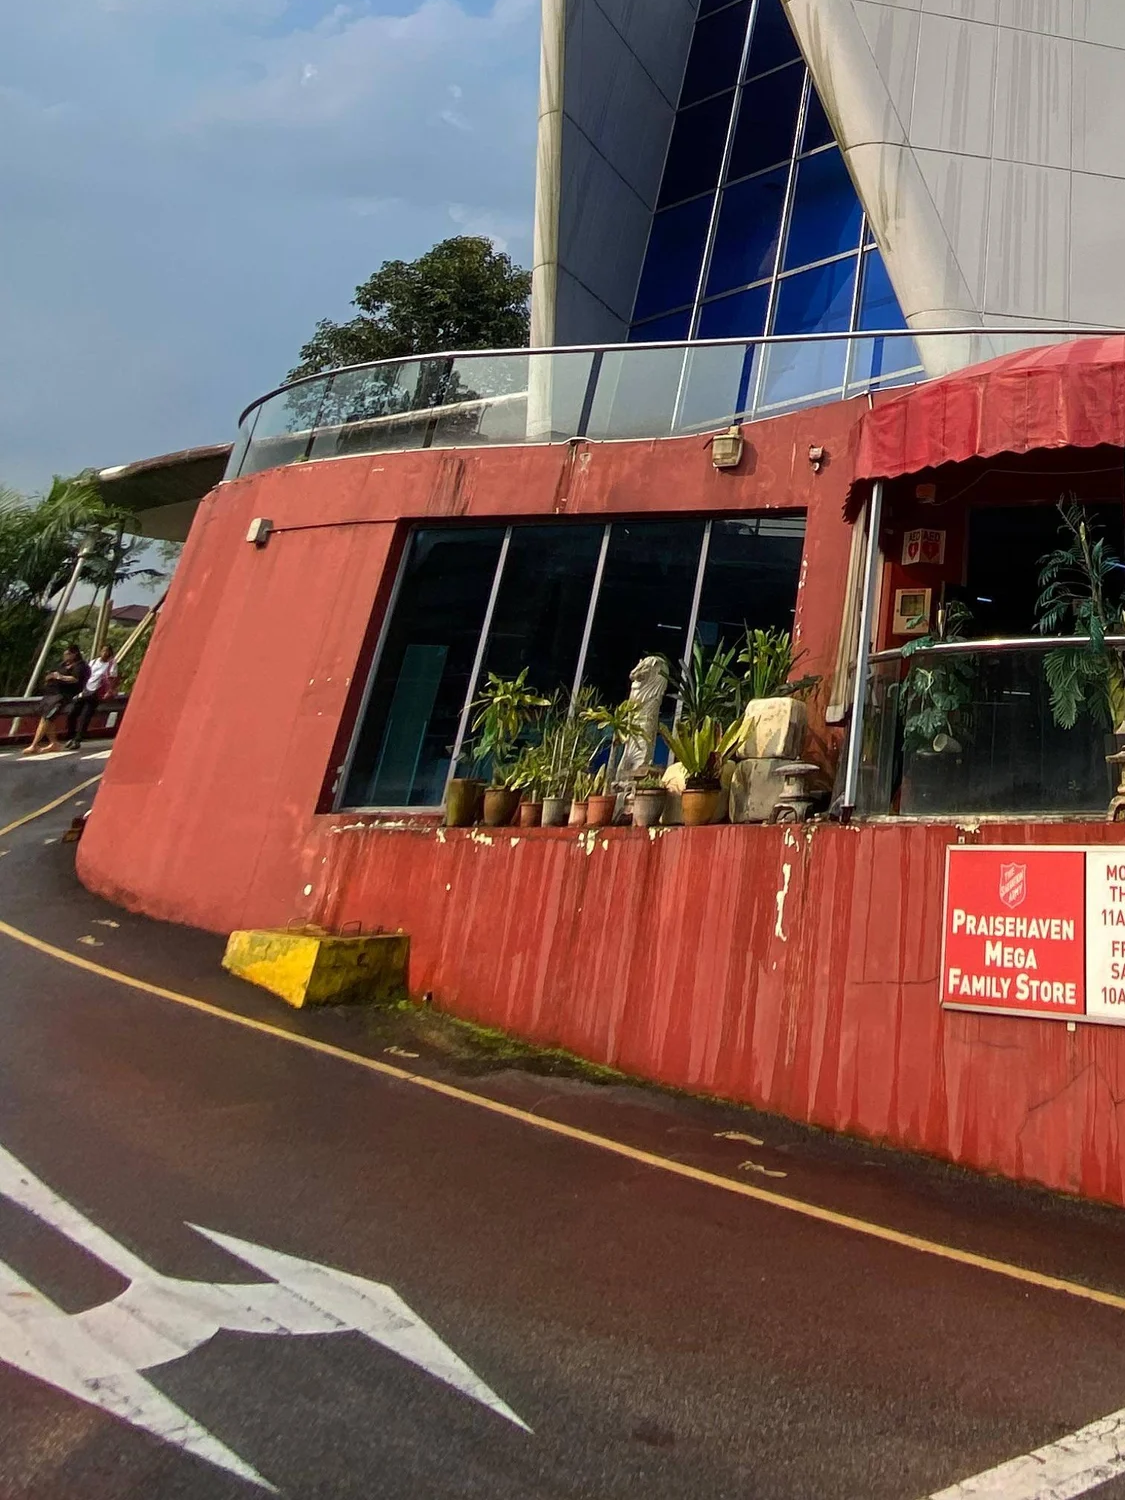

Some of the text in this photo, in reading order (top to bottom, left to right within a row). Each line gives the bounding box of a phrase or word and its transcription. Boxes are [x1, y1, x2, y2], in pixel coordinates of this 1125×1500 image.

[952, 908, 1074, 941] PRAISEHAVEN
[984, 940, 1037, 969] MEGA
[948, 968, 1077, 1005] FAMILY STORE
